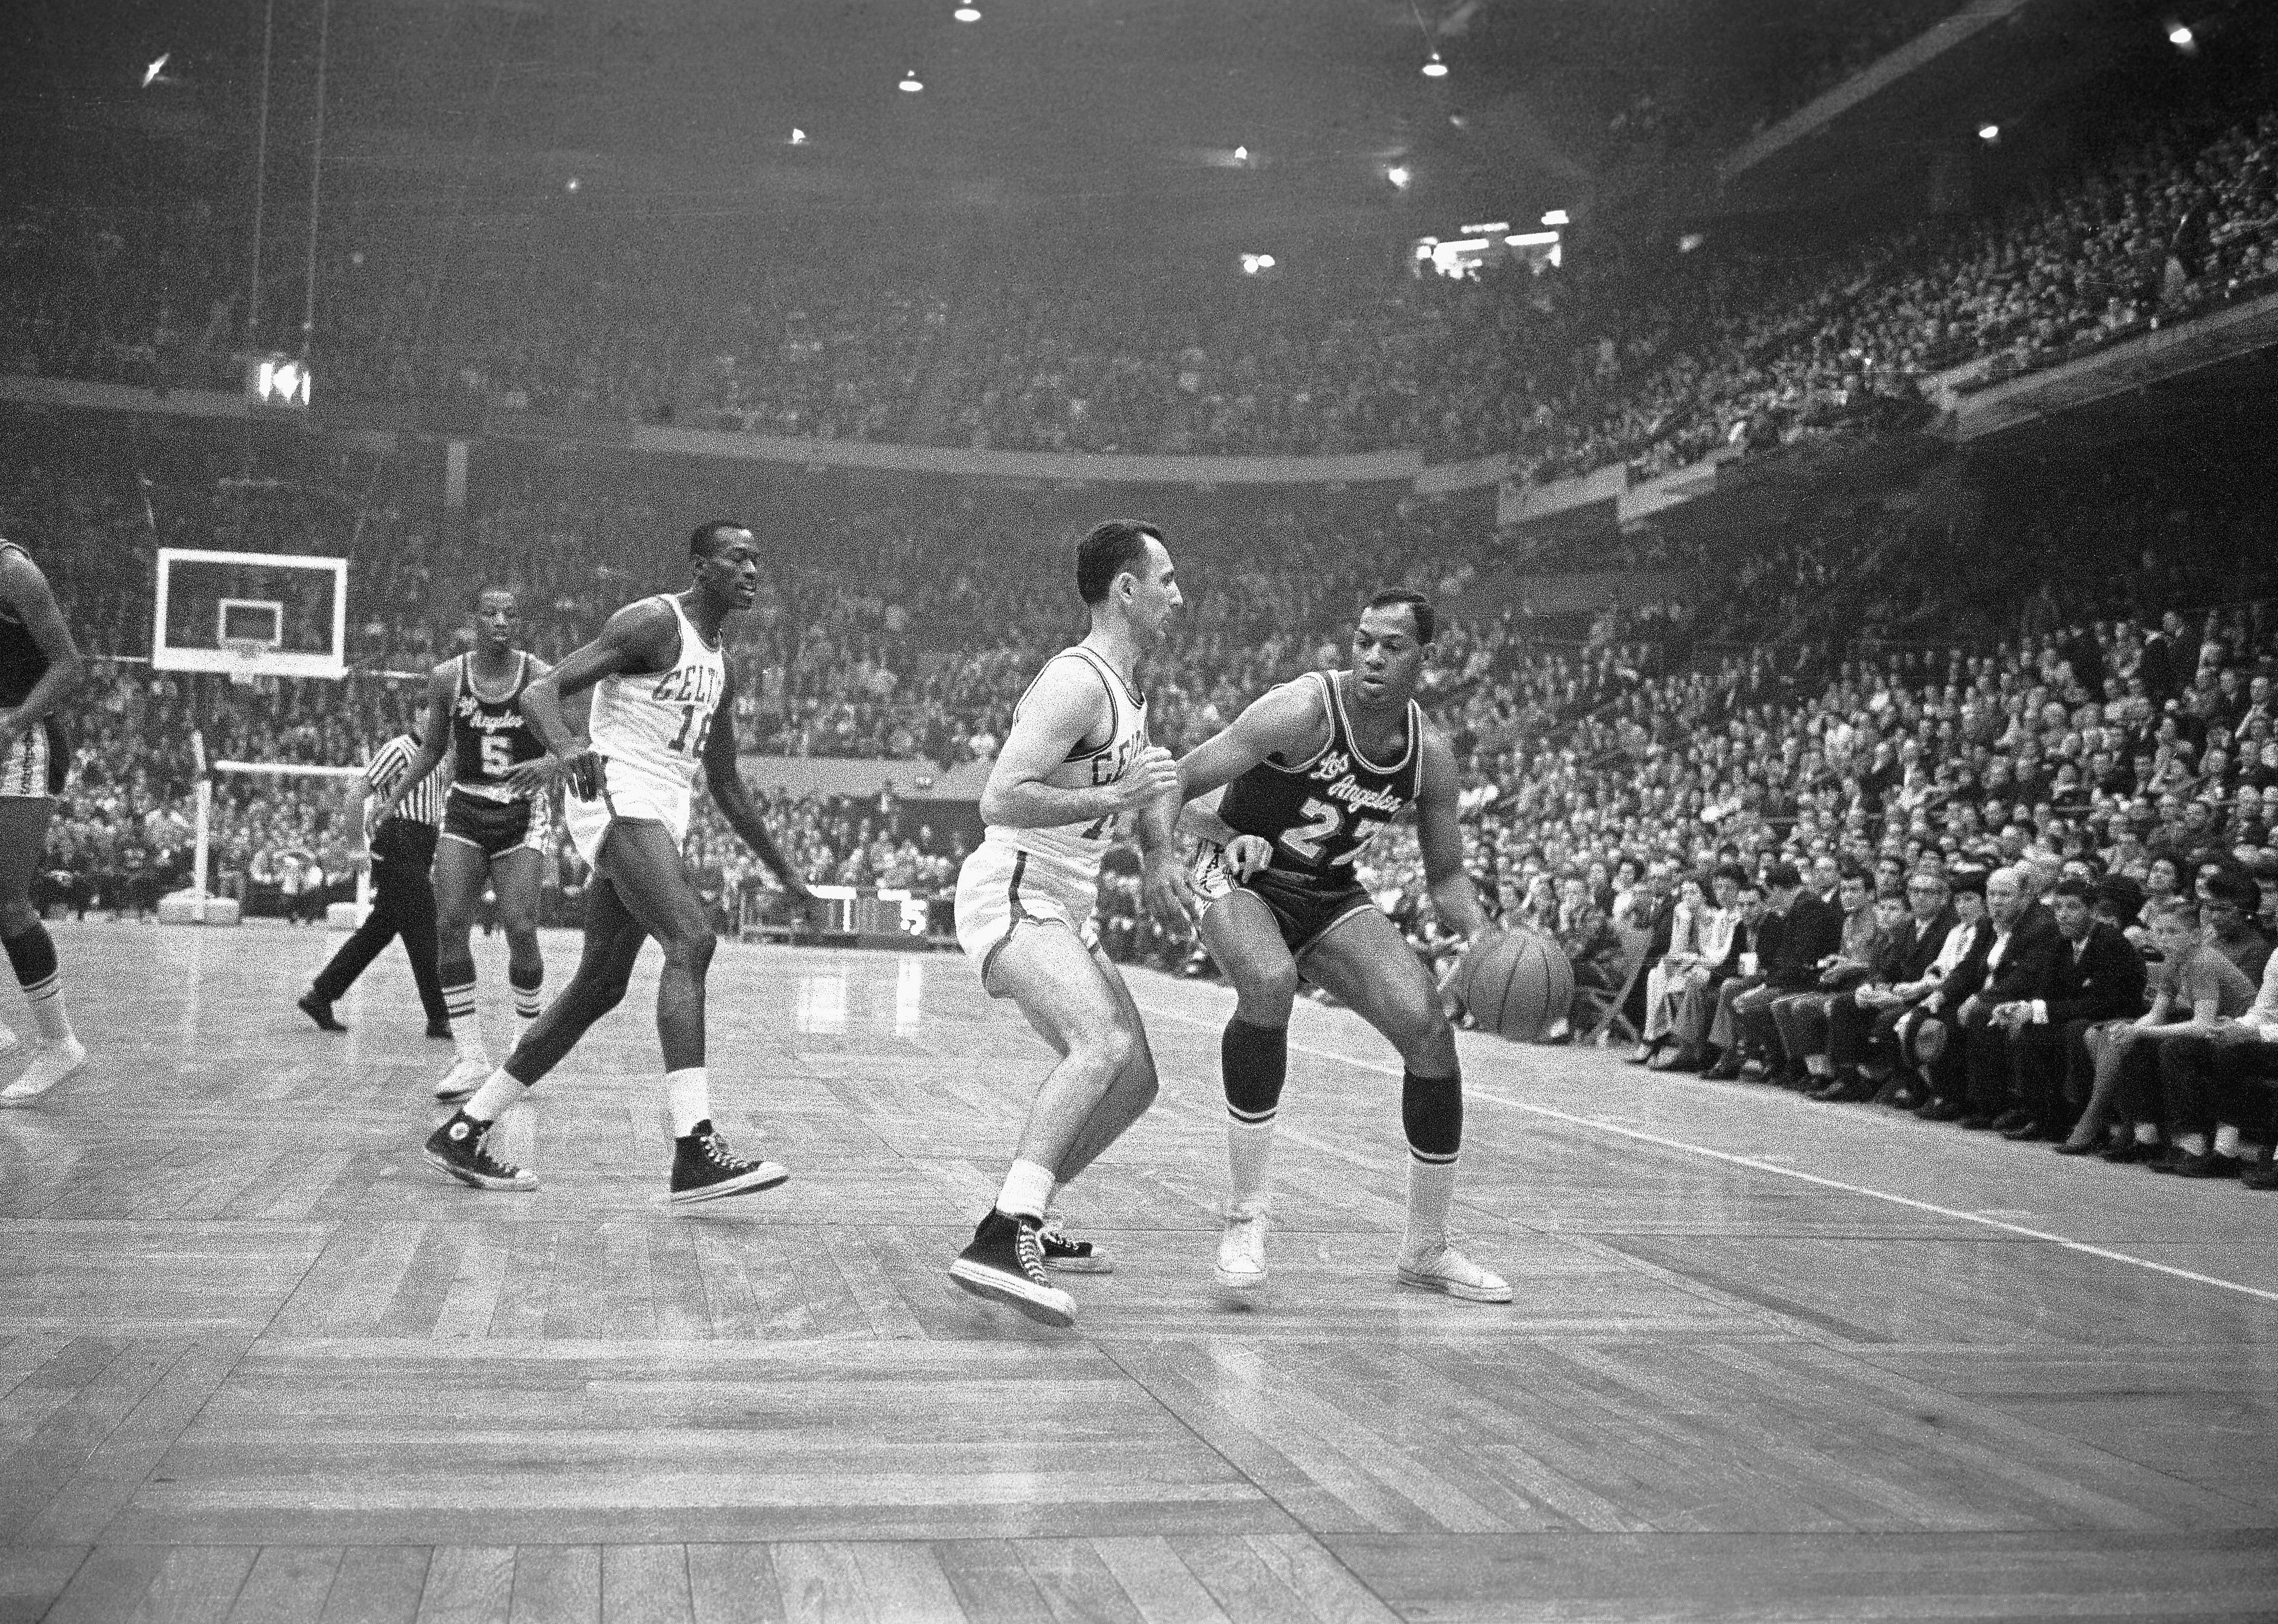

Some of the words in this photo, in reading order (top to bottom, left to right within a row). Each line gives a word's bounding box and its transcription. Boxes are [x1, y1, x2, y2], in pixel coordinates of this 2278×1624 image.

[481, 736, 512, 777] 5
[1309, 750, 1349, 780] Los
[1327, 773, 1403, 814] Angeles
